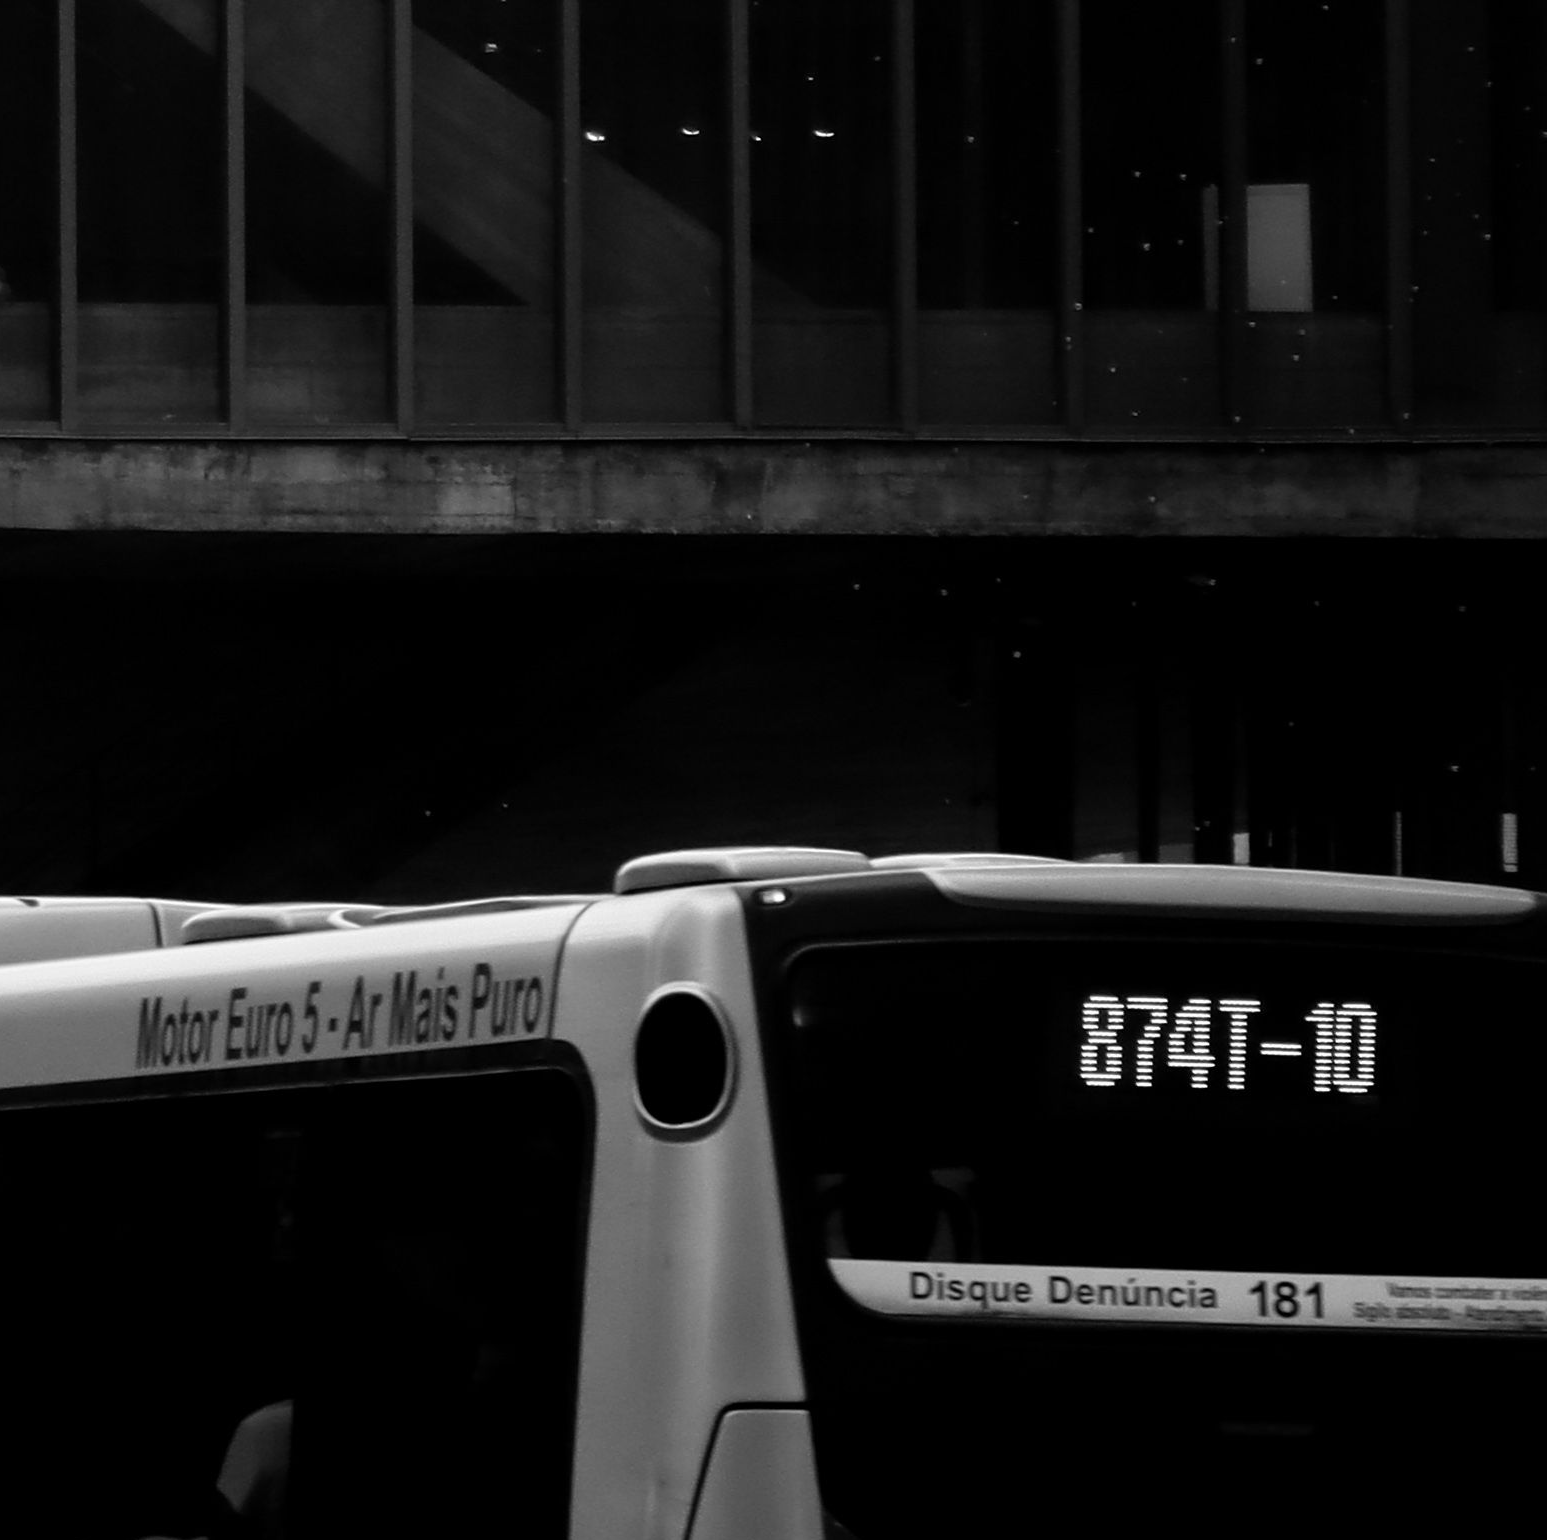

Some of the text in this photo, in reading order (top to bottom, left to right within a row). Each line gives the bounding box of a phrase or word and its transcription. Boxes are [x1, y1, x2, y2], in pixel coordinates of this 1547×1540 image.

[135, 994, 219, 1069] Motor
[225, 986, 291, 1061] Euro
[301, 980, 322, 1055] 5
[343, 975, 383, 1049] Ar
[388, 967, 457, 1047] Mais
[469, 962, 543, 1040] Puro
[1079, 994, 1377, 1093] 874T-10
[909, 1270, 1033, 1308] Disque
[1047, 1275, 1218, 1311] Denúncia
[1246, 1281, 1326, 1320] 181
